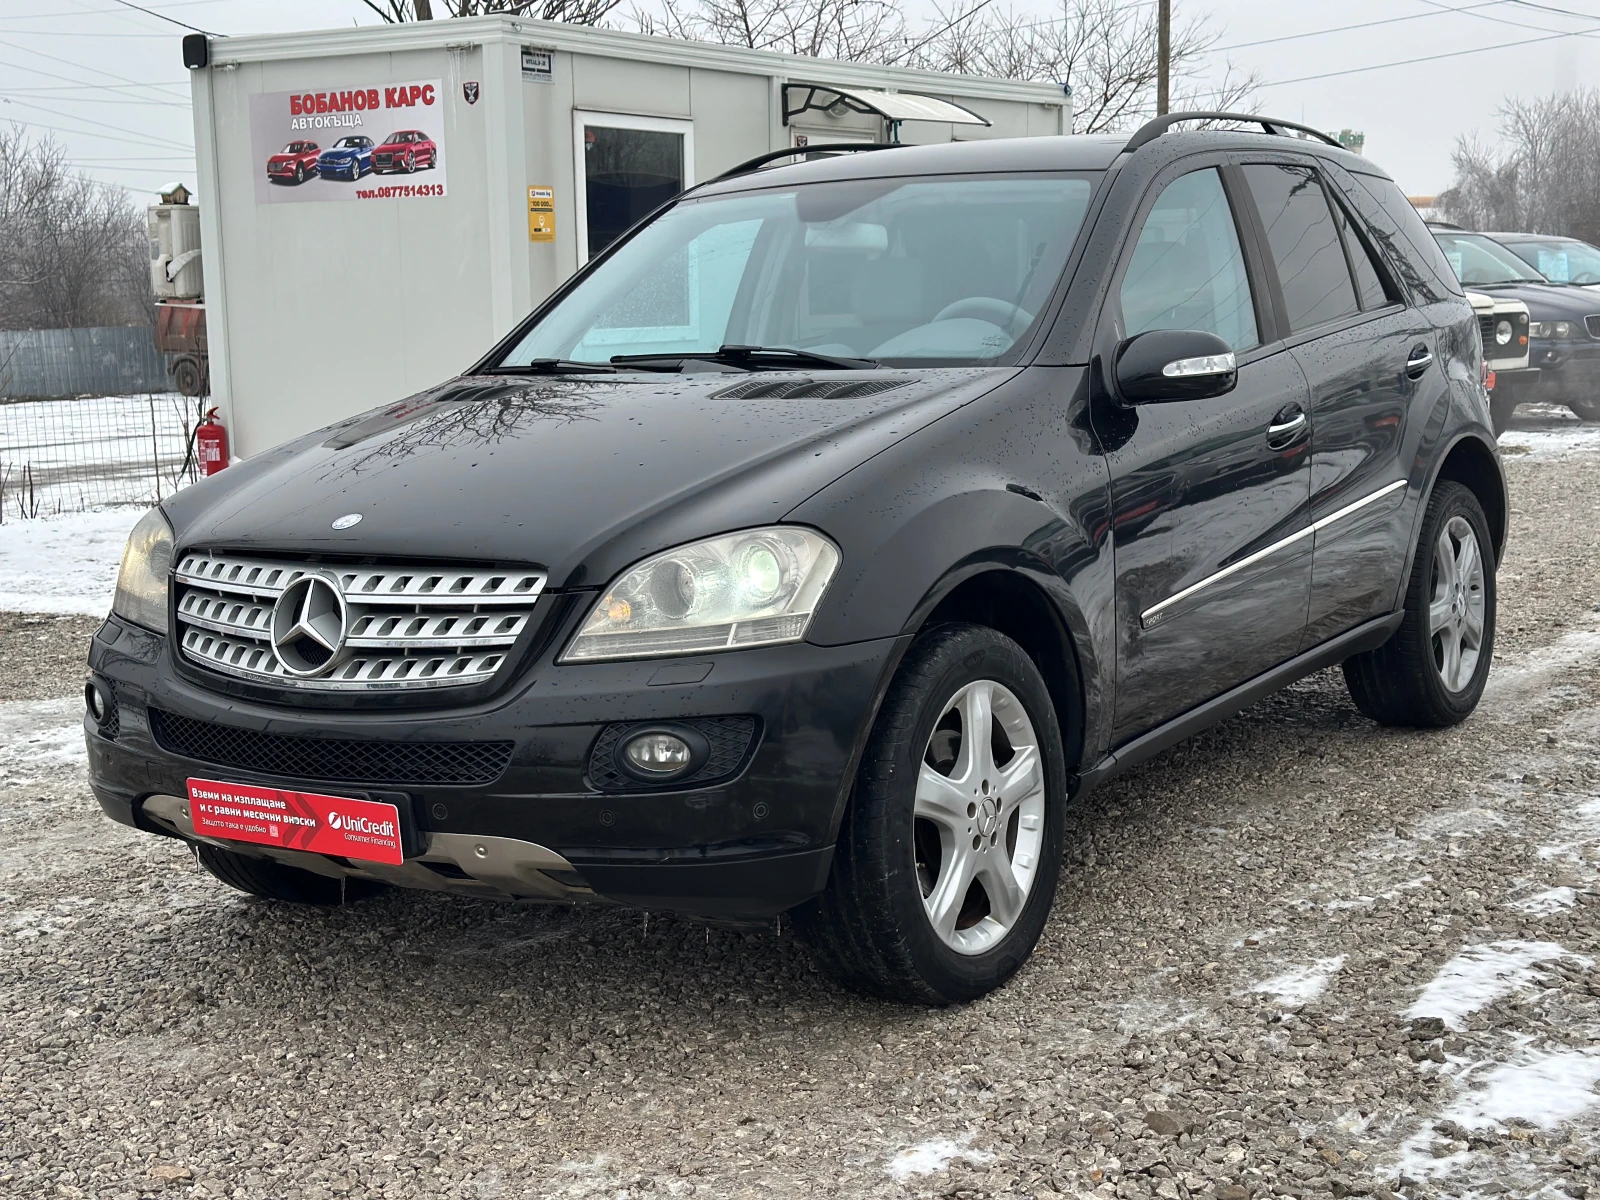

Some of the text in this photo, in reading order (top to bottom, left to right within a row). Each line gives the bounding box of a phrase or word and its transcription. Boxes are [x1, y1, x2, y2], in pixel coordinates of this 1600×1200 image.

[290, 84, 435, 115] БОБАНОВ КАРС
[291, 113, 363, 130] АВТОКЪЩА
[356, 184, 444, 199] тел.0877514313
[191, 787, 286, 810] Вземи на изплащане
[199, 803, 316, 827] и с равни месечни вноски
[202, 817, 225, 828] Защото
[225, 821, 239, 830] така
[244, 824, 267, 834] удобно
[342, 814, 395, 837] UniCredit
[344, 832, 397, 849] Consumer Financing
